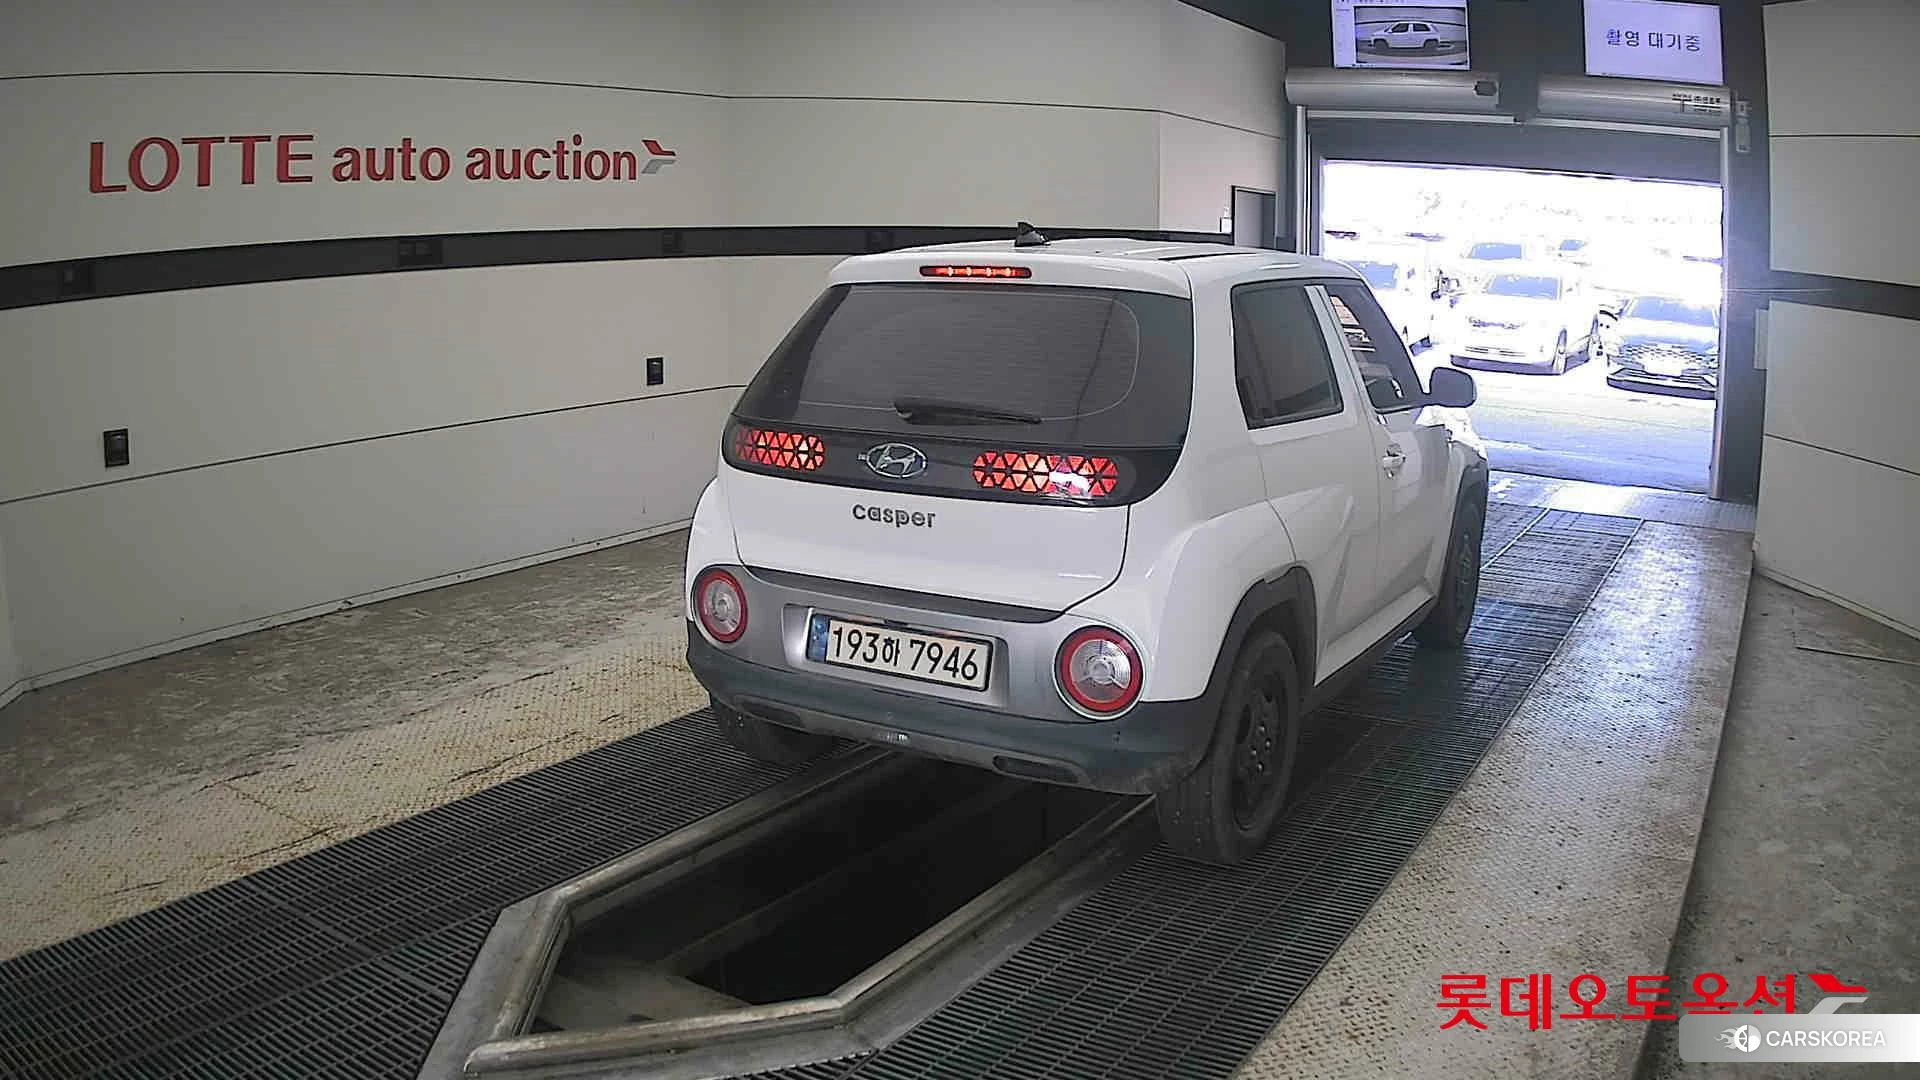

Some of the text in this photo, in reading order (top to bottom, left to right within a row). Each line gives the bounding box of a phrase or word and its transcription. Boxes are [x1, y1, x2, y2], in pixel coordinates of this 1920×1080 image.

[1648, 32, 1700, 52] 대기중
[89, 134, 638, 193] LOTTE auto auction
[852, 504, 936, 528] casper
[833, 626, 979, 681] 193하 7946
